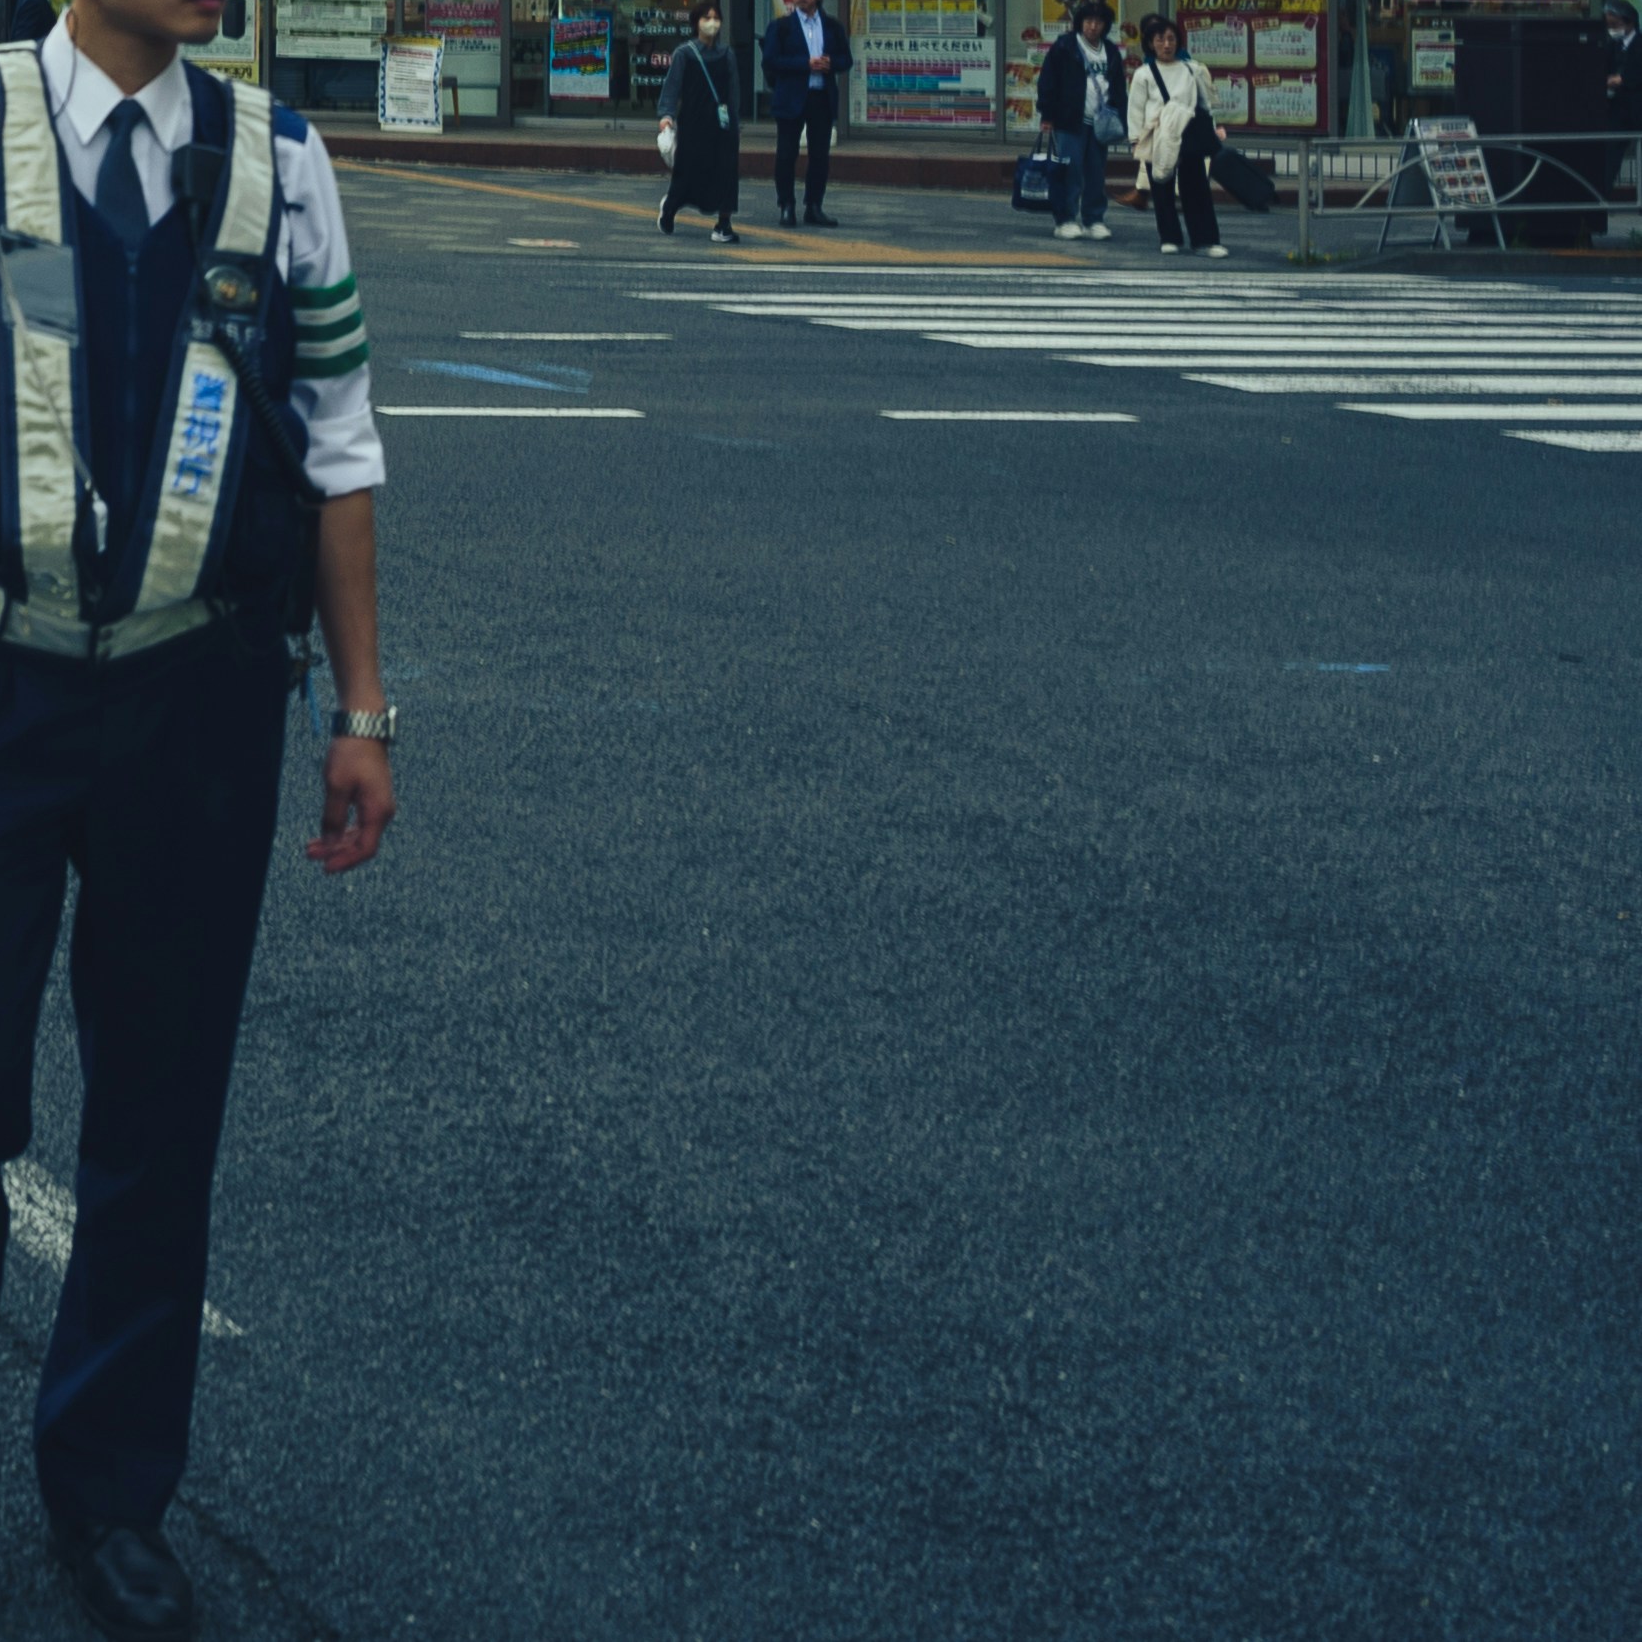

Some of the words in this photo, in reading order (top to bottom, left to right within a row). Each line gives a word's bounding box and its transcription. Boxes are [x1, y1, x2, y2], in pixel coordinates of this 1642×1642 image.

[863, 39, 905, 52] スマホ代
[908, 40, 982, 52] 比べてください
[173, 372, 228, 496] 警視庁
